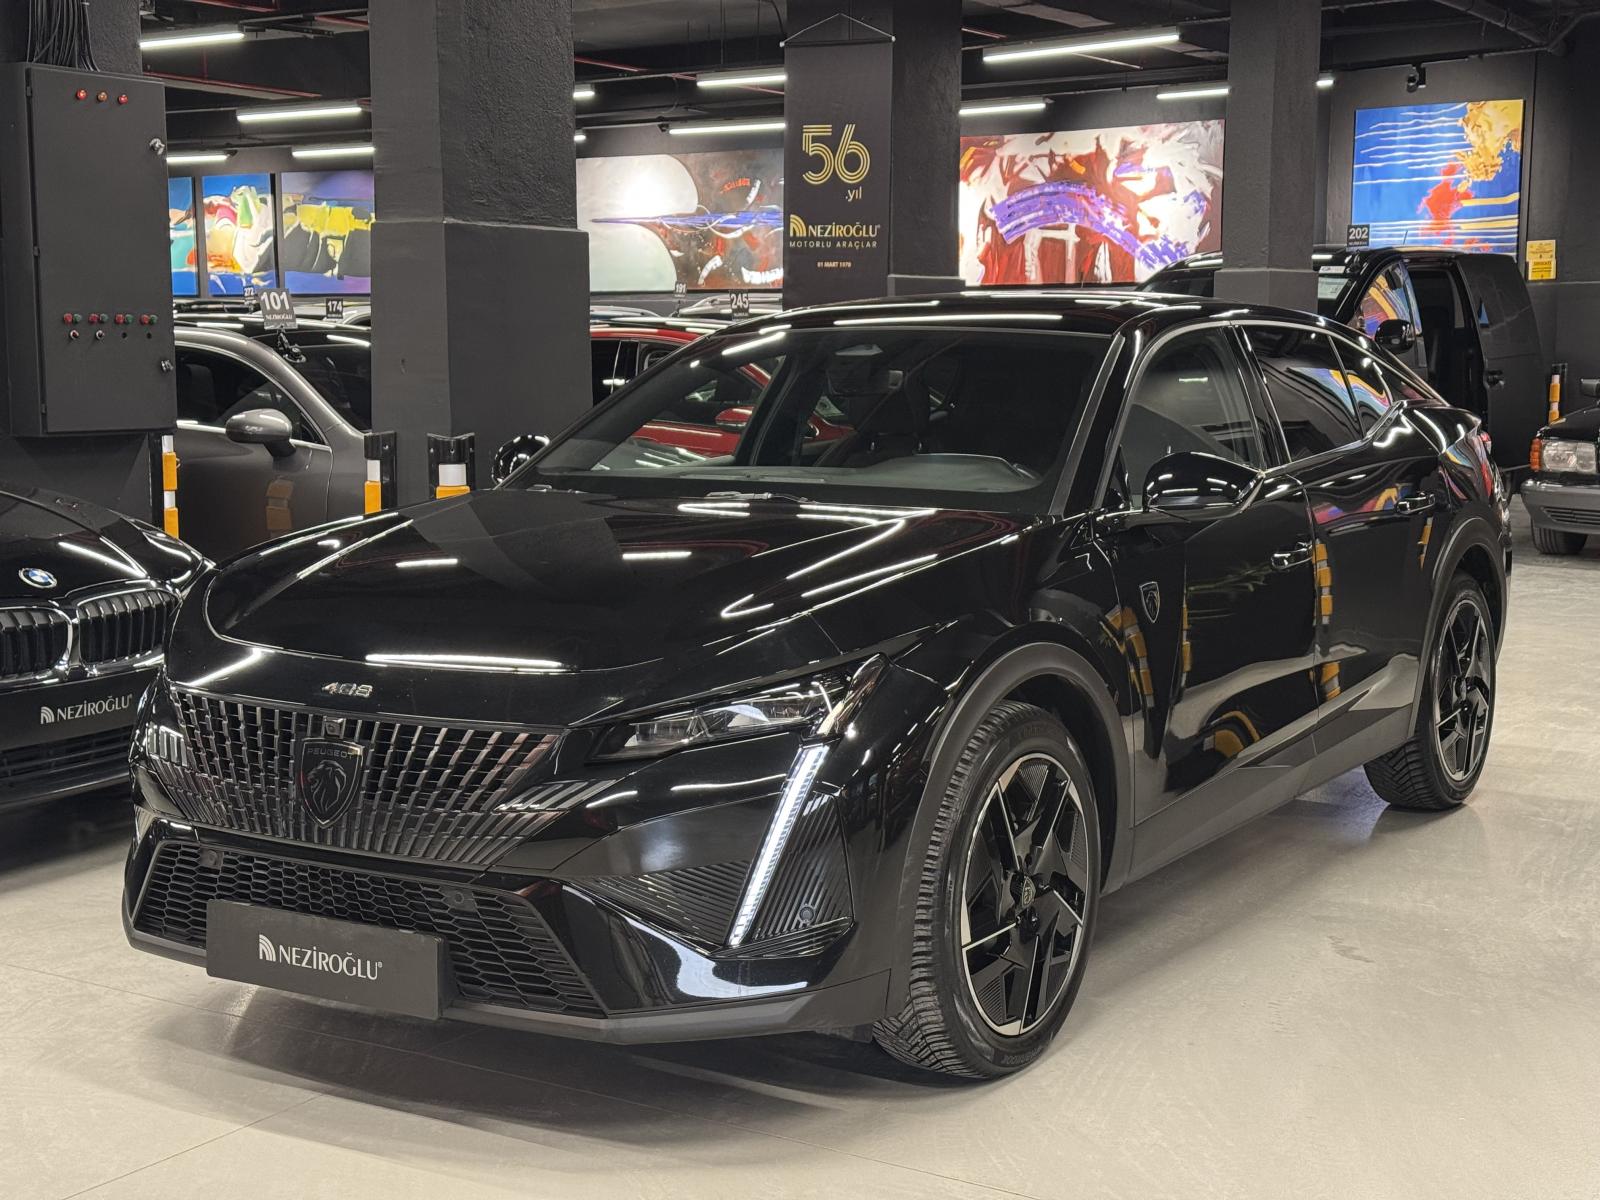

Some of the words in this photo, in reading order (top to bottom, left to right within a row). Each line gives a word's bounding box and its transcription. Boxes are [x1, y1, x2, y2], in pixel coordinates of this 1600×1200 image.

[802, 123, 870, 185] 56
[1348, 227, 1369, 239] 202
[789, 240, 832, 248] MOTORLU
[836, 240, 878, 250] ARAÇLAR
[675, 283, 687, 293] 191
[260, 291, 290, 311] 101
[327, 301, 343, 312] 174
[730, 293, 749, 309] 245
[321, 681, 374, 699] 408
[306, 747, 353, 760] PEUGEOT
